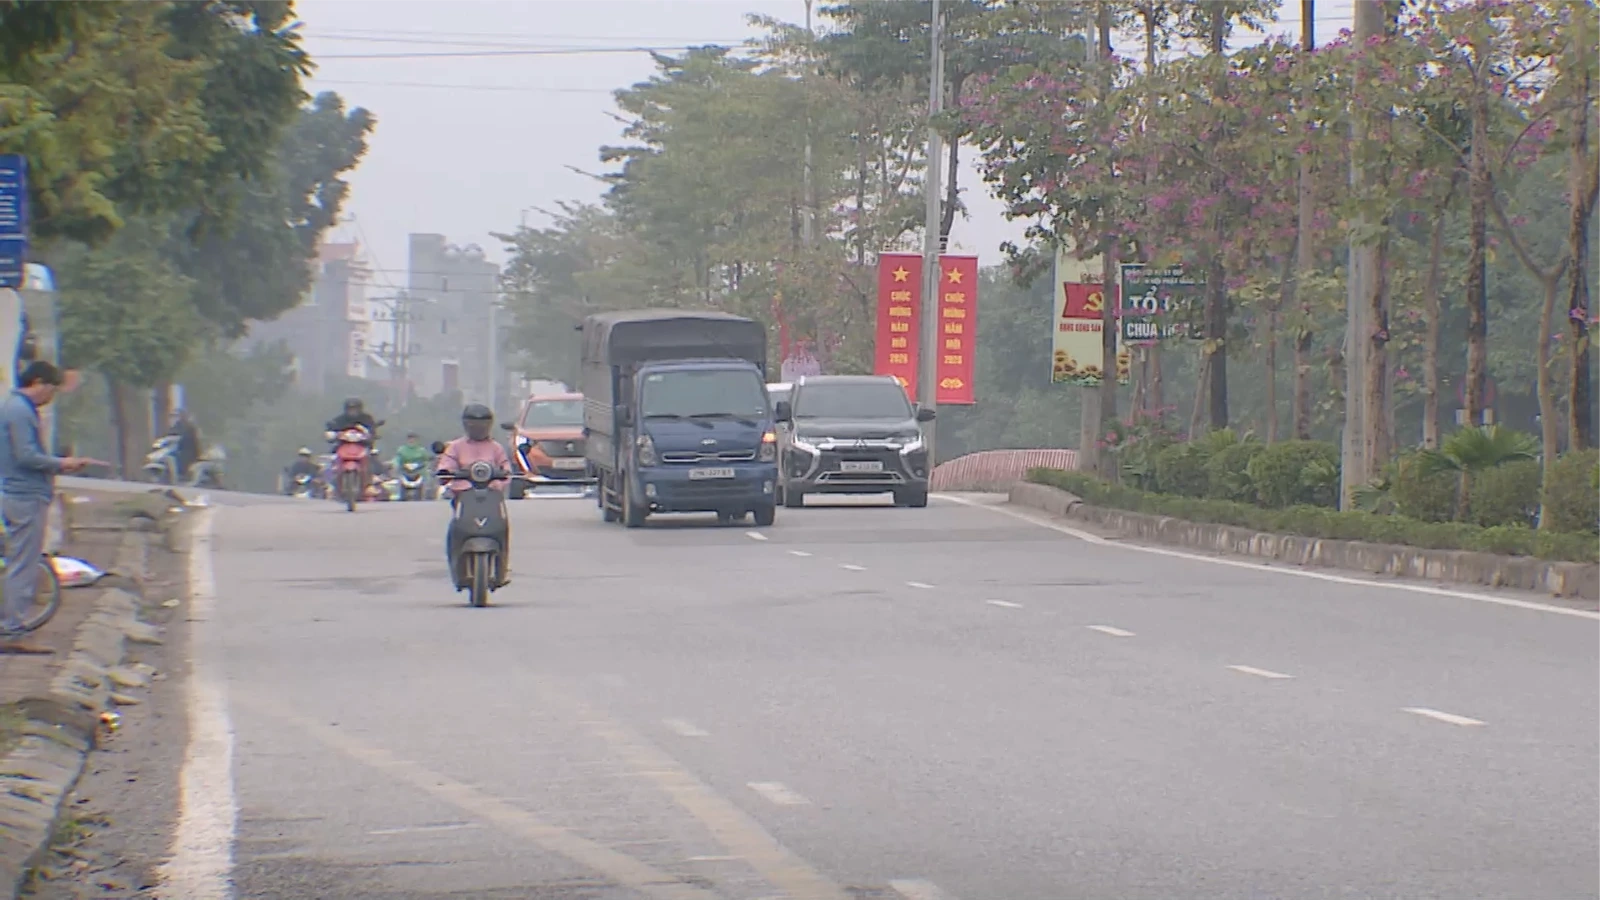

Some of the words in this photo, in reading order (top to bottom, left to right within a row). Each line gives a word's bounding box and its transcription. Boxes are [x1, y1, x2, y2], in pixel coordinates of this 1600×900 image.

[891, 290, 912, 302] CHÚC
[944, 291, 965, 303] CHÚC
[1128, 285, 1158, 314] TỔ
[889, 306, 912, 317] MỪNG
[943, 307, 966, 318] MỪNG
[891, 322, 909, 332] NĂM
[944, 322, 963, 334] NĂM
[1127, 316, 1158, 337] CHÙA
[891, 337, 907, 348] MỚI
[945, 338, 961, 350] MỚI
